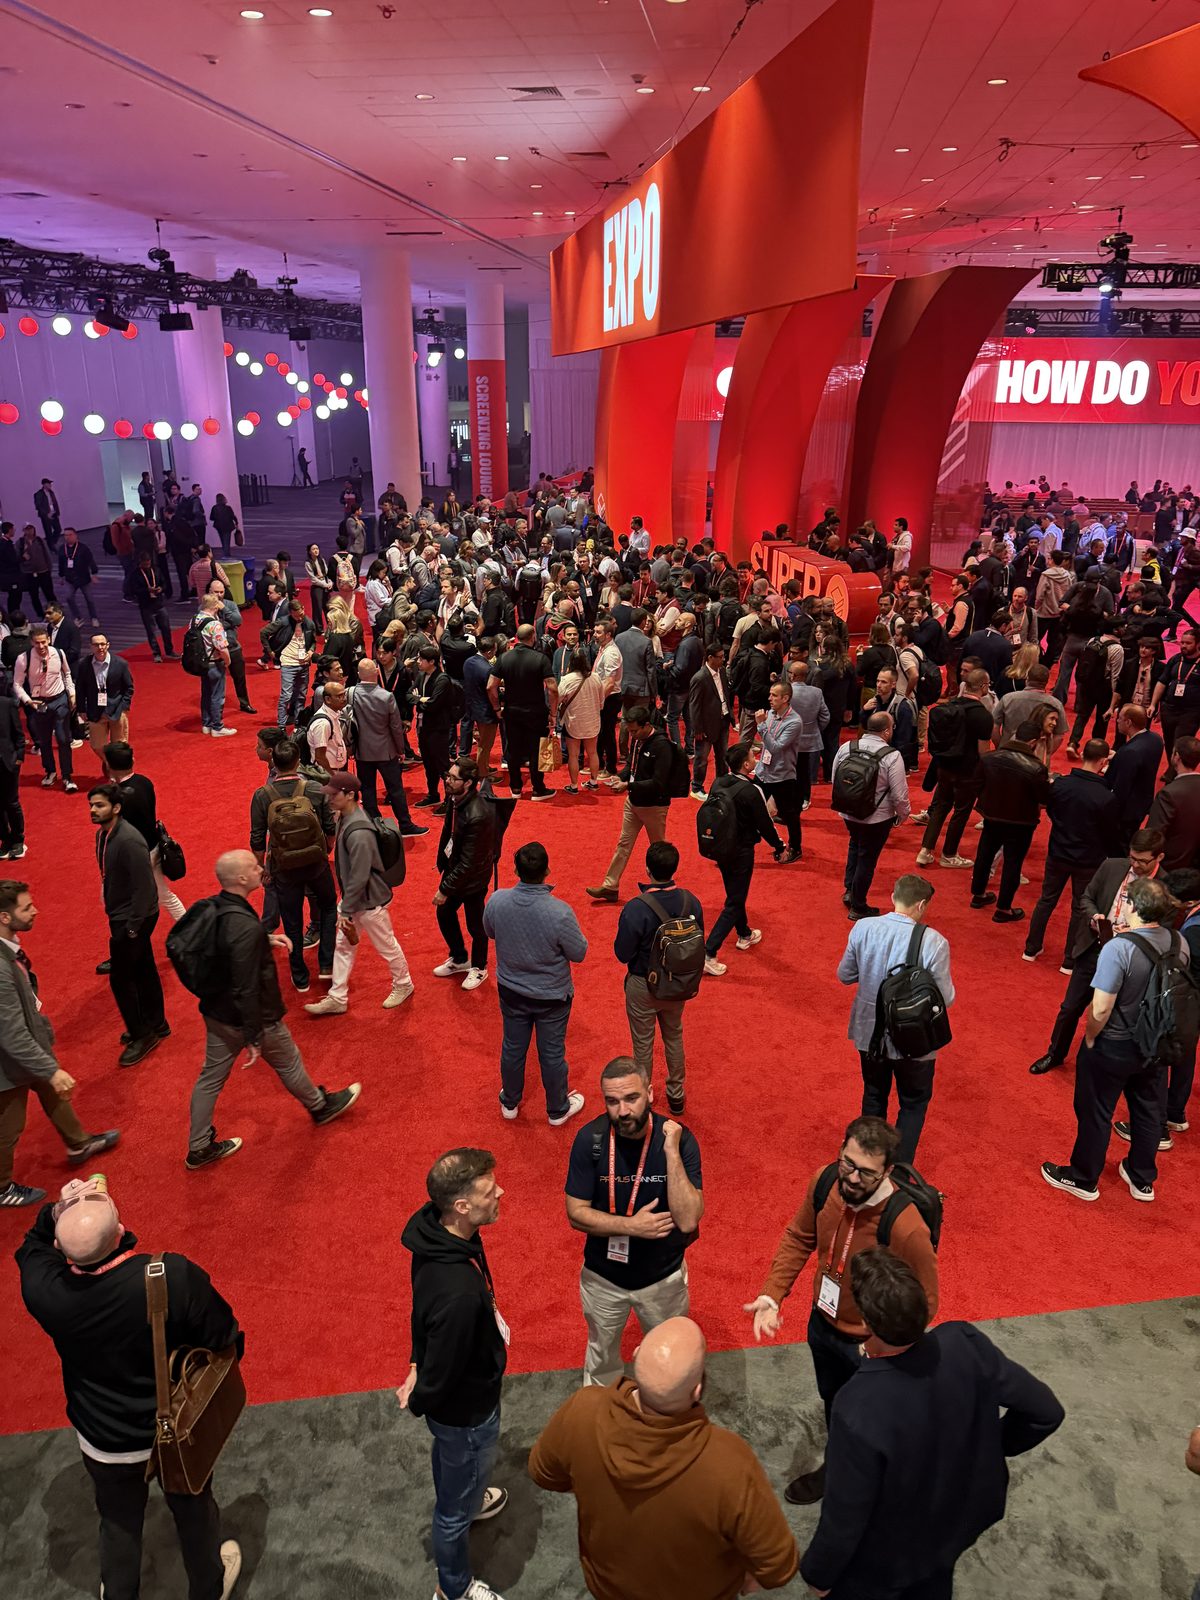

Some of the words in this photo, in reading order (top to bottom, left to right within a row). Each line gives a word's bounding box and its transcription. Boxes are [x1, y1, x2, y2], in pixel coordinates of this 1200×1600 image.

[604, 183, 661, 332] EXPO
[476, 375, 491, 450] SCREENING
[995, 360, 1090, 404] HOW
[1091, 360, 1150, 405] DO
